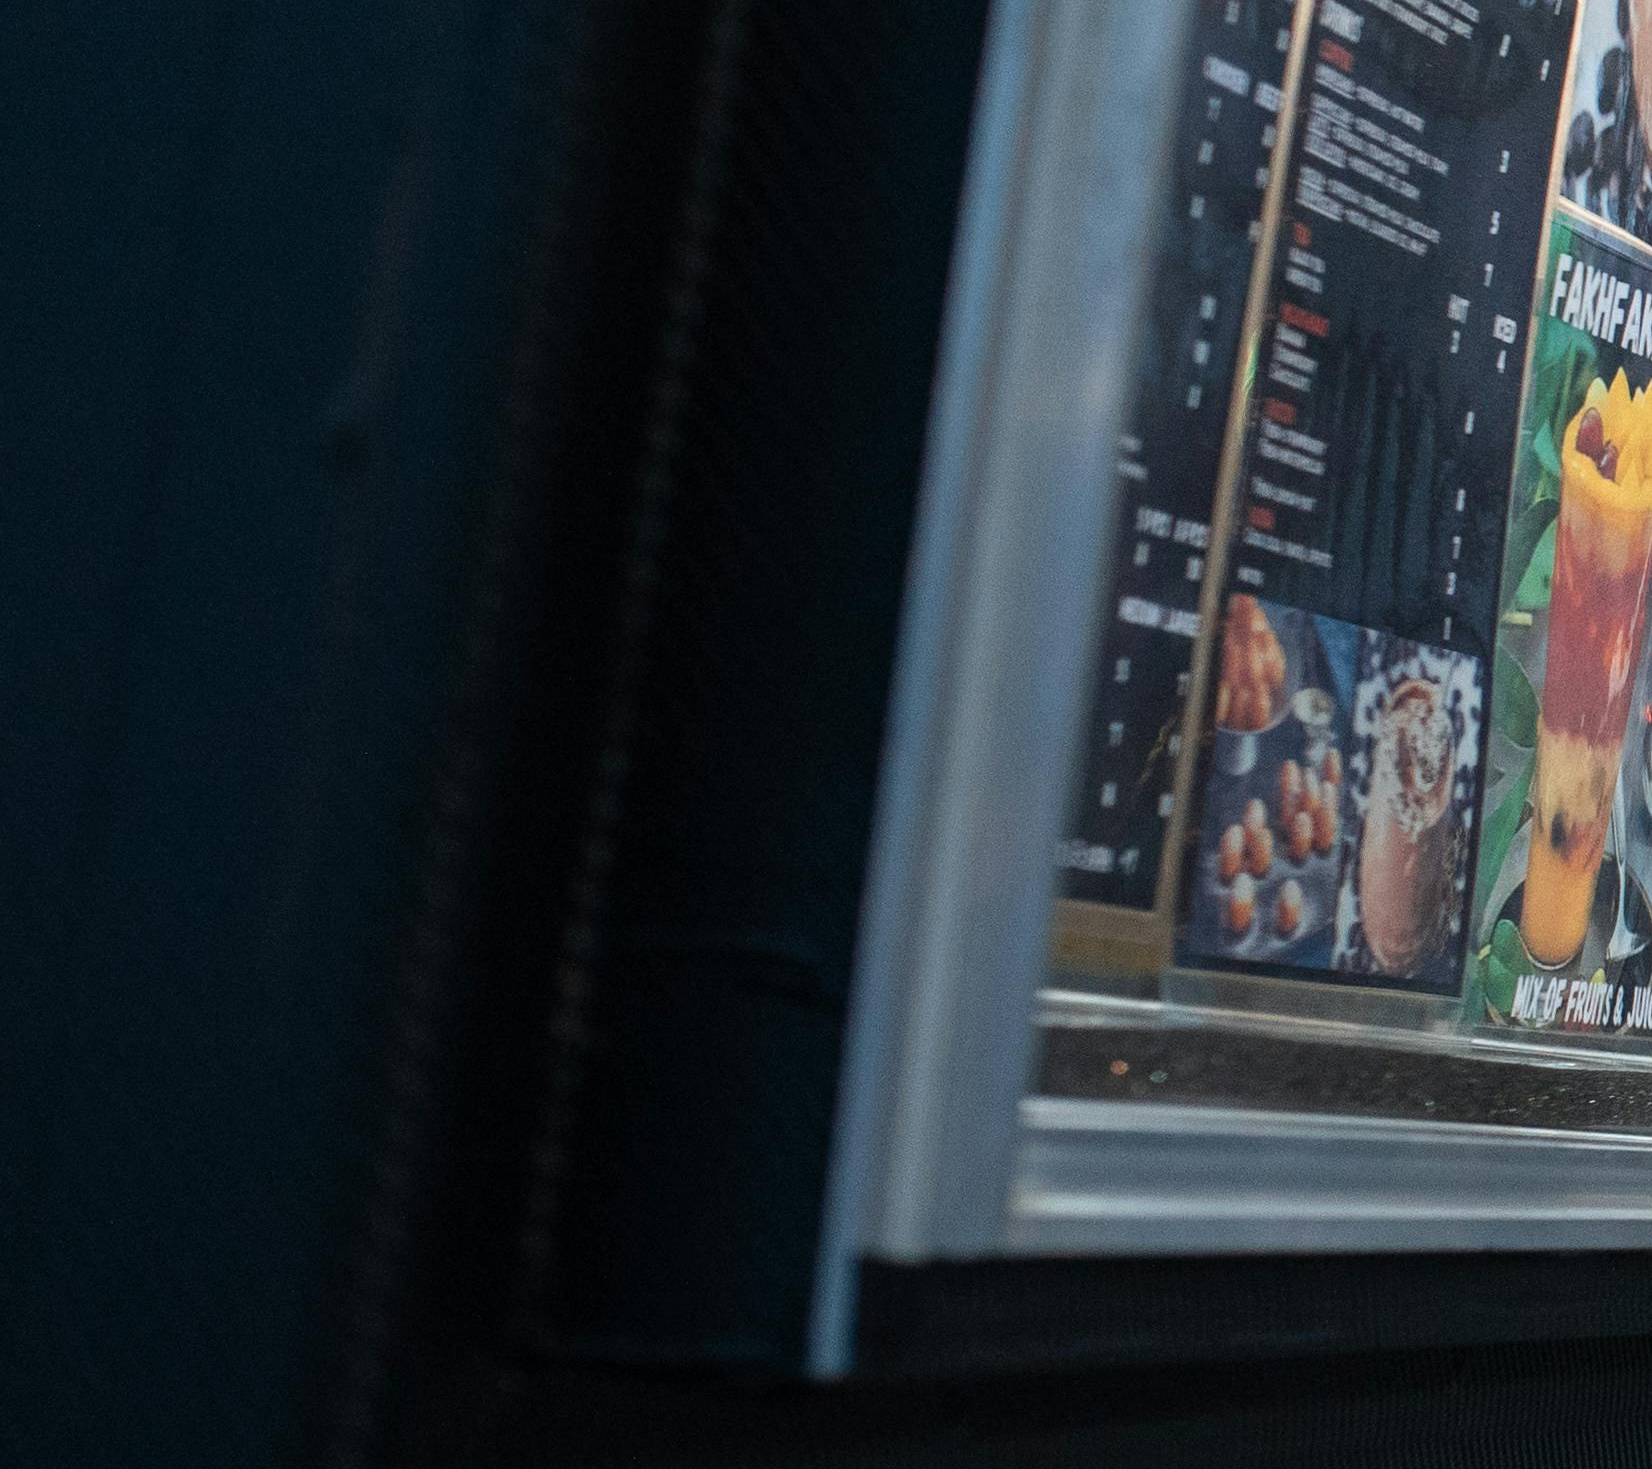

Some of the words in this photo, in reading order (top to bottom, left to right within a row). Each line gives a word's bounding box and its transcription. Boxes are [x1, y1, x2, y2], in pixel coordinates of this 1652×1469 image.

[1511, 974, 1544, 1021] MIX
[1543, 978, 1568, 1023] OF
[1564, 981, 1613, 1026] FRUITS
[1613, 985, 1625, 1027] &
